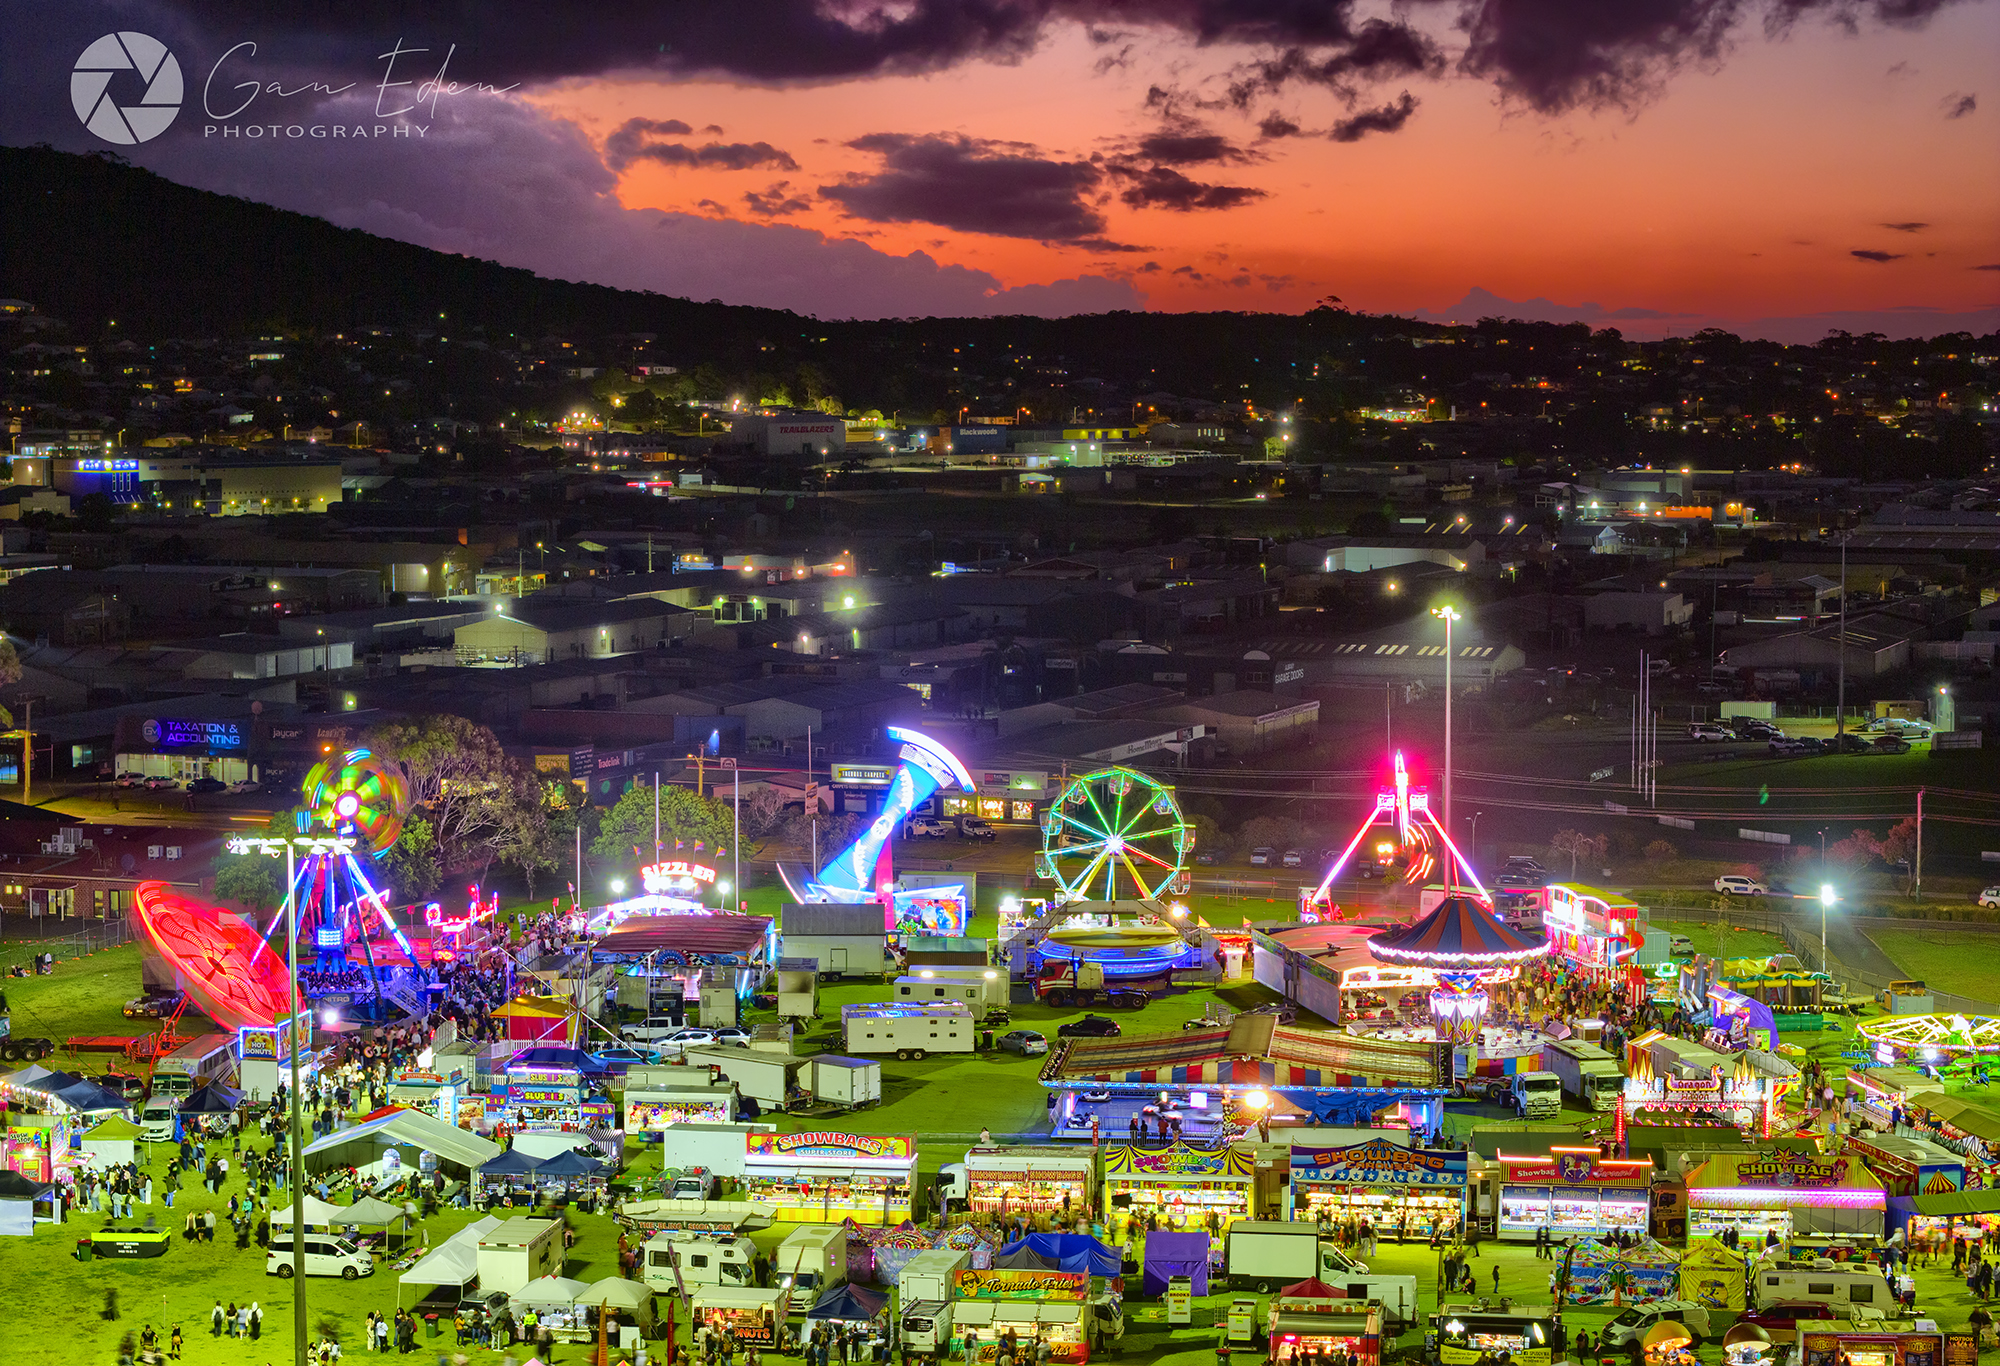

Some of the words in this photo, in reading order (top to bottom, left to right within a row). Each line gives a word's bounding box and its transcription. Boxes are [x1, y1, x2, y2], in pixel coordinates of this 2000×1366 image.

[779, 425, 834, 434] TRAILBLAZERS
[959, 427, 998, 436] Blackwoods
[167, 721, 226, 733] TAXATION
[229, 724, 239, 734] &
[167, 732, 240, 746] ACCOUNTING
[272, 729, 299, 739] jaycar
[598, 756, 620, 768] Tradelink
[985, 789, 1010, 797] avenue
[642, 862, 716, 884] SIZZLER
[323, 994, 350, 1003] NITRO
[251, 1041, 266, 1049] HOT
[245, 1048, 273, 1056] DONUTS
[525, 1092, 565, 1101] SLUSHIES
[778, 1131, 881, 1154] SHOWBAGS
[1133, 1154, 1226, 1170] SHOWBAG
[1314, 1150, 1446, 1169] SHOWBAG
[1346, 1161, 1420, 1171] CAROUSEL
[1739, 1163, 1832, 1177] SHOWBAG
[970, 1171, 1024, 1181] SHOWBAGS
[1029, 1171, 1084, 1181] SHOWBAGS
[1517, 1168, 1556, 1178] Showbag
[1555, 1191, 1596, 1200] SHOWBAGS
[639, 1222, 655, 1230] THE
[658, 1222, 682, 1231] BLING
[987, 1277, 1039, 1292] Tornado
[1041, 1277, 1075, 1291] Fries
